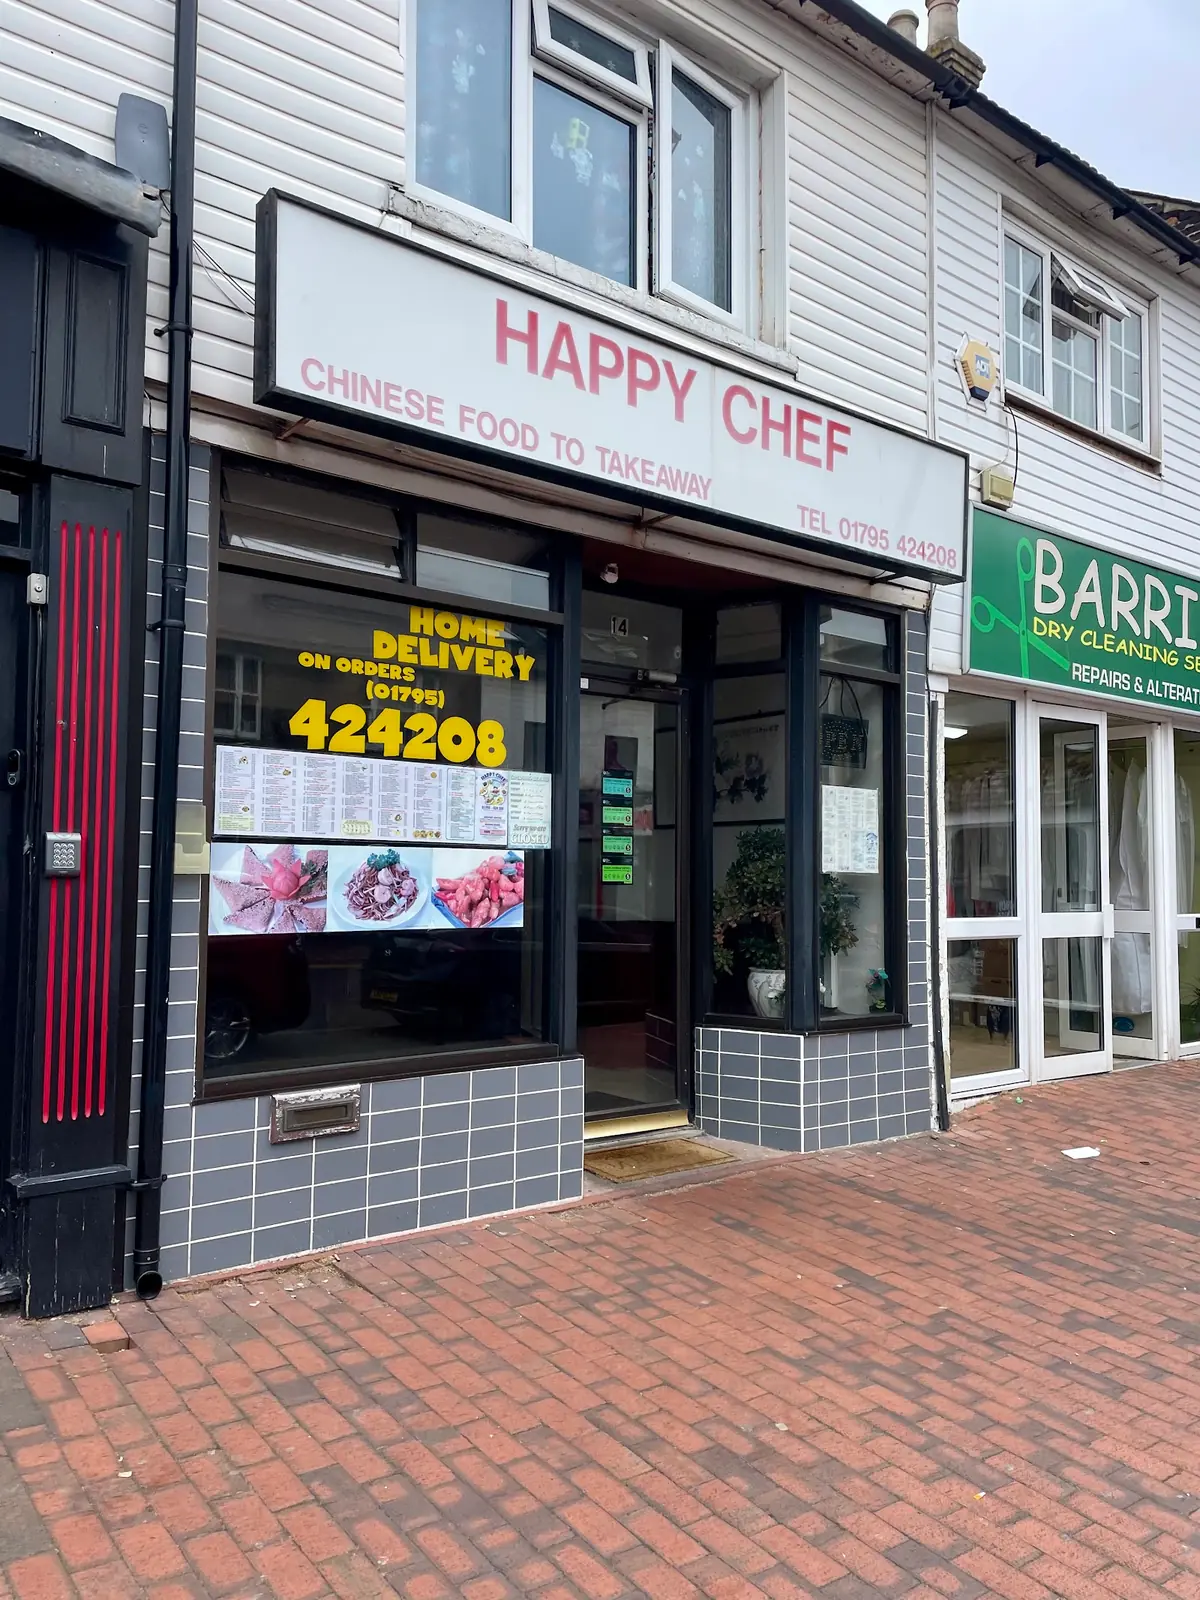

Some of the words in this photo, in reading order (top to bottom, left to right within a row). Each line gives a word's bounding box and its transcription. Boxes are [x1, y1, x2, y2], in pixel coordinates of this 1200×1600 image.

[496, 298, 697, 423] HAPPY
[722, 384, 851, 472] CHEF
[300, 358, 445, 427] CHINESE
[459, 404, 539, 452] FOOD
[550, 432, 585, 466] TO
[595, 446, 712, 501] TAKEAWAY
[797, 504, 832, 535] TEL
[839, 517, 889, 550] 01795
[896, 534, 957, 569] 424208
[1034, 538, 1199, 650] BARRI
[408, 606, 505, 648] HOME
[611, 616, 628, 636] 14
[1033, 616, 1075, 642] DRY
[1080, 630, 1179, 666] CLEANING
[298, 652, 331, 670] ON
[335, 658, 416, 682] ORDERS
[373, 629, 535, 681] DELIVERY
[1072, 662, 1130, 691] REPAIRS
[1134, 677, 1144, 693] &
[366, 679, 445, 710] (01795)
[289, 698, 507, 768] 424208
